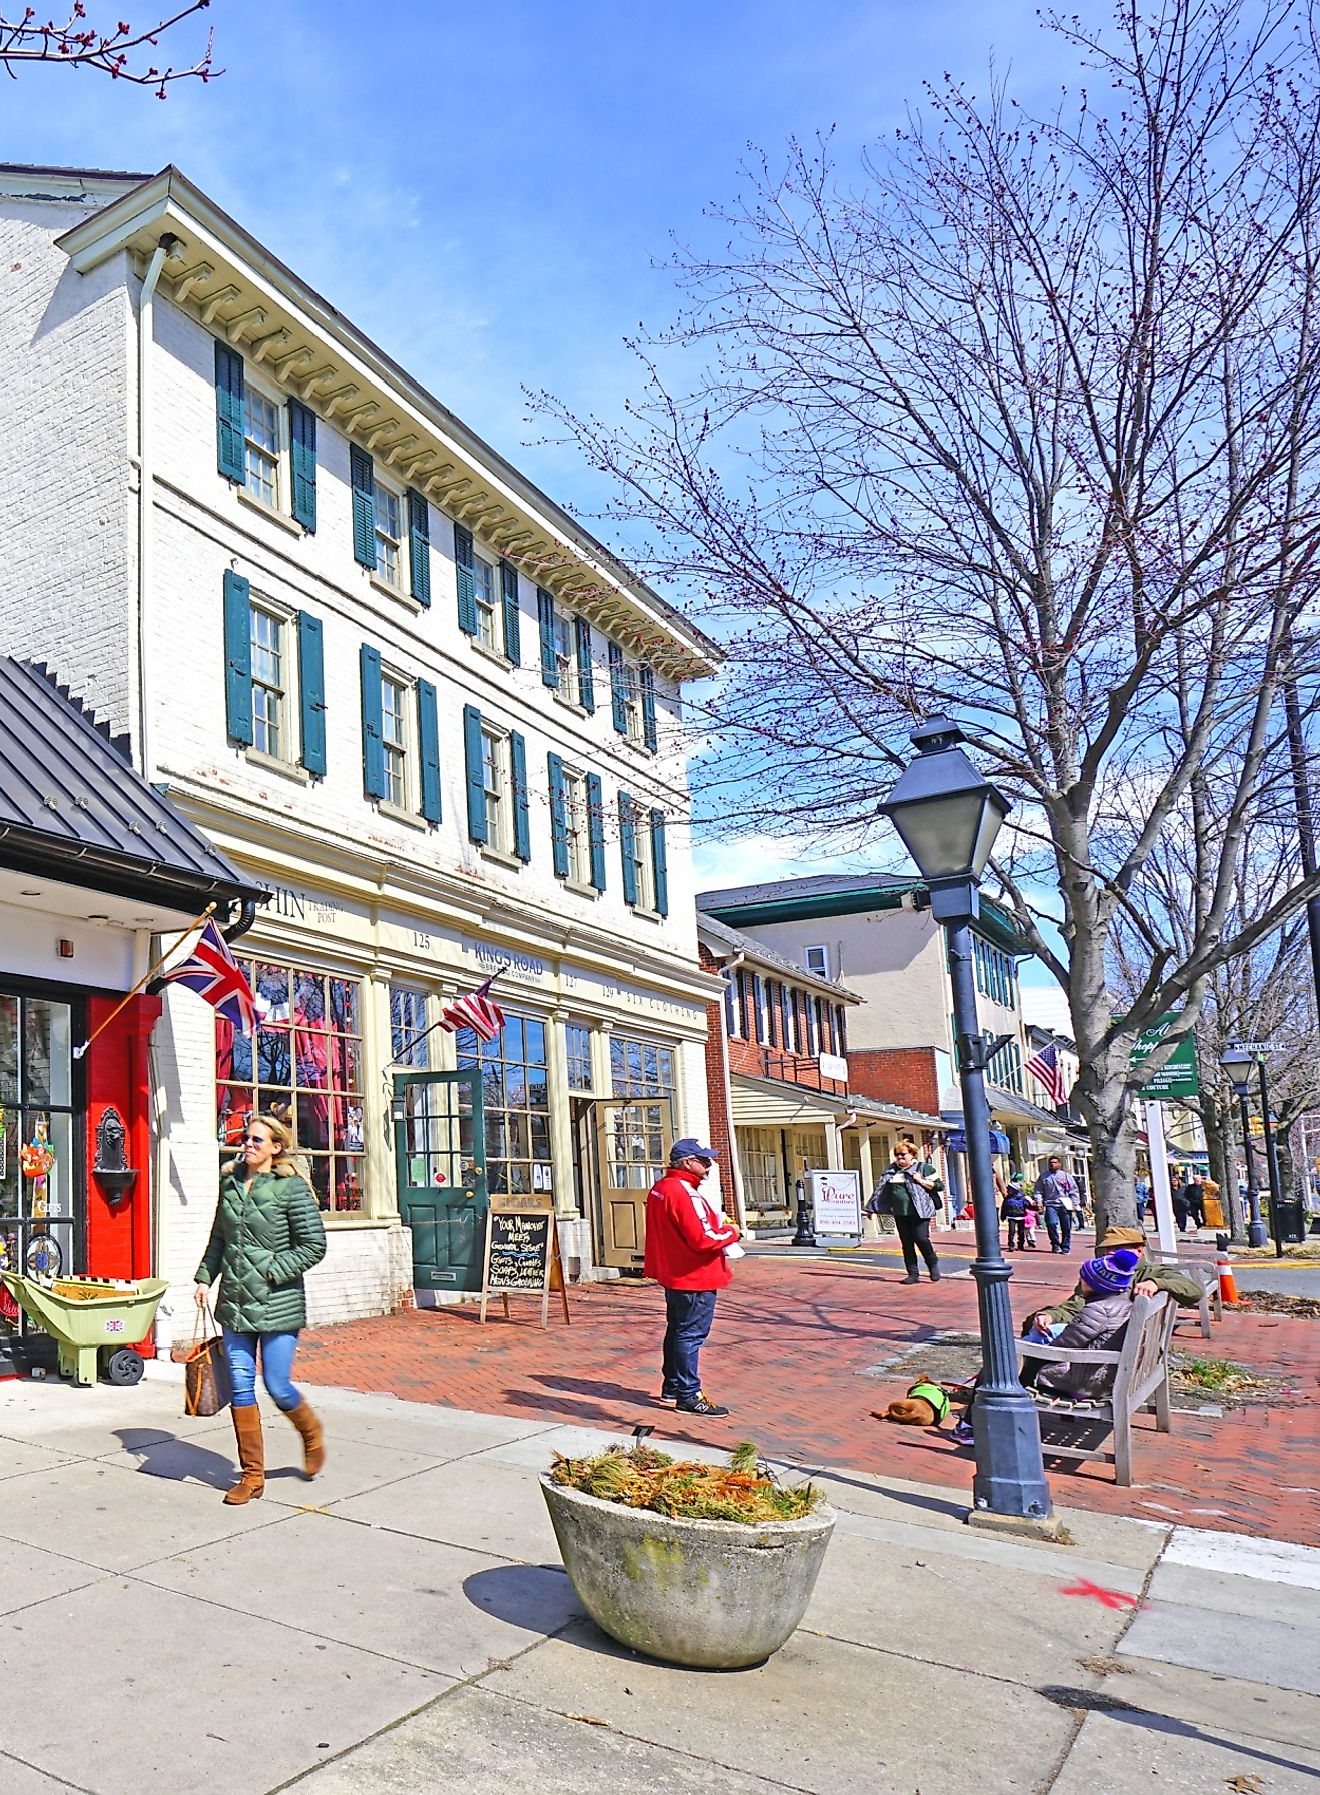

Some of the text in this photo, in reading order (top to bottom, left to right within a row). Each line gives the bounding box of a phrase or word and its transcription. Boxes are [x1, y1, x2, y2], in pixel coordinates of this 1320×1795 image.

[317, 912, 336, 923] POST
[413, 931, 430, 950] 125
[475, 943, 543, 976] KING'S ROAD
[511, 971, 535, 982] COMPANY
[565, 974, 577, 988] 127
[649, 999, 697, 1020] CLOTHING
[1093, 1260, 1119, 1283] STATE
